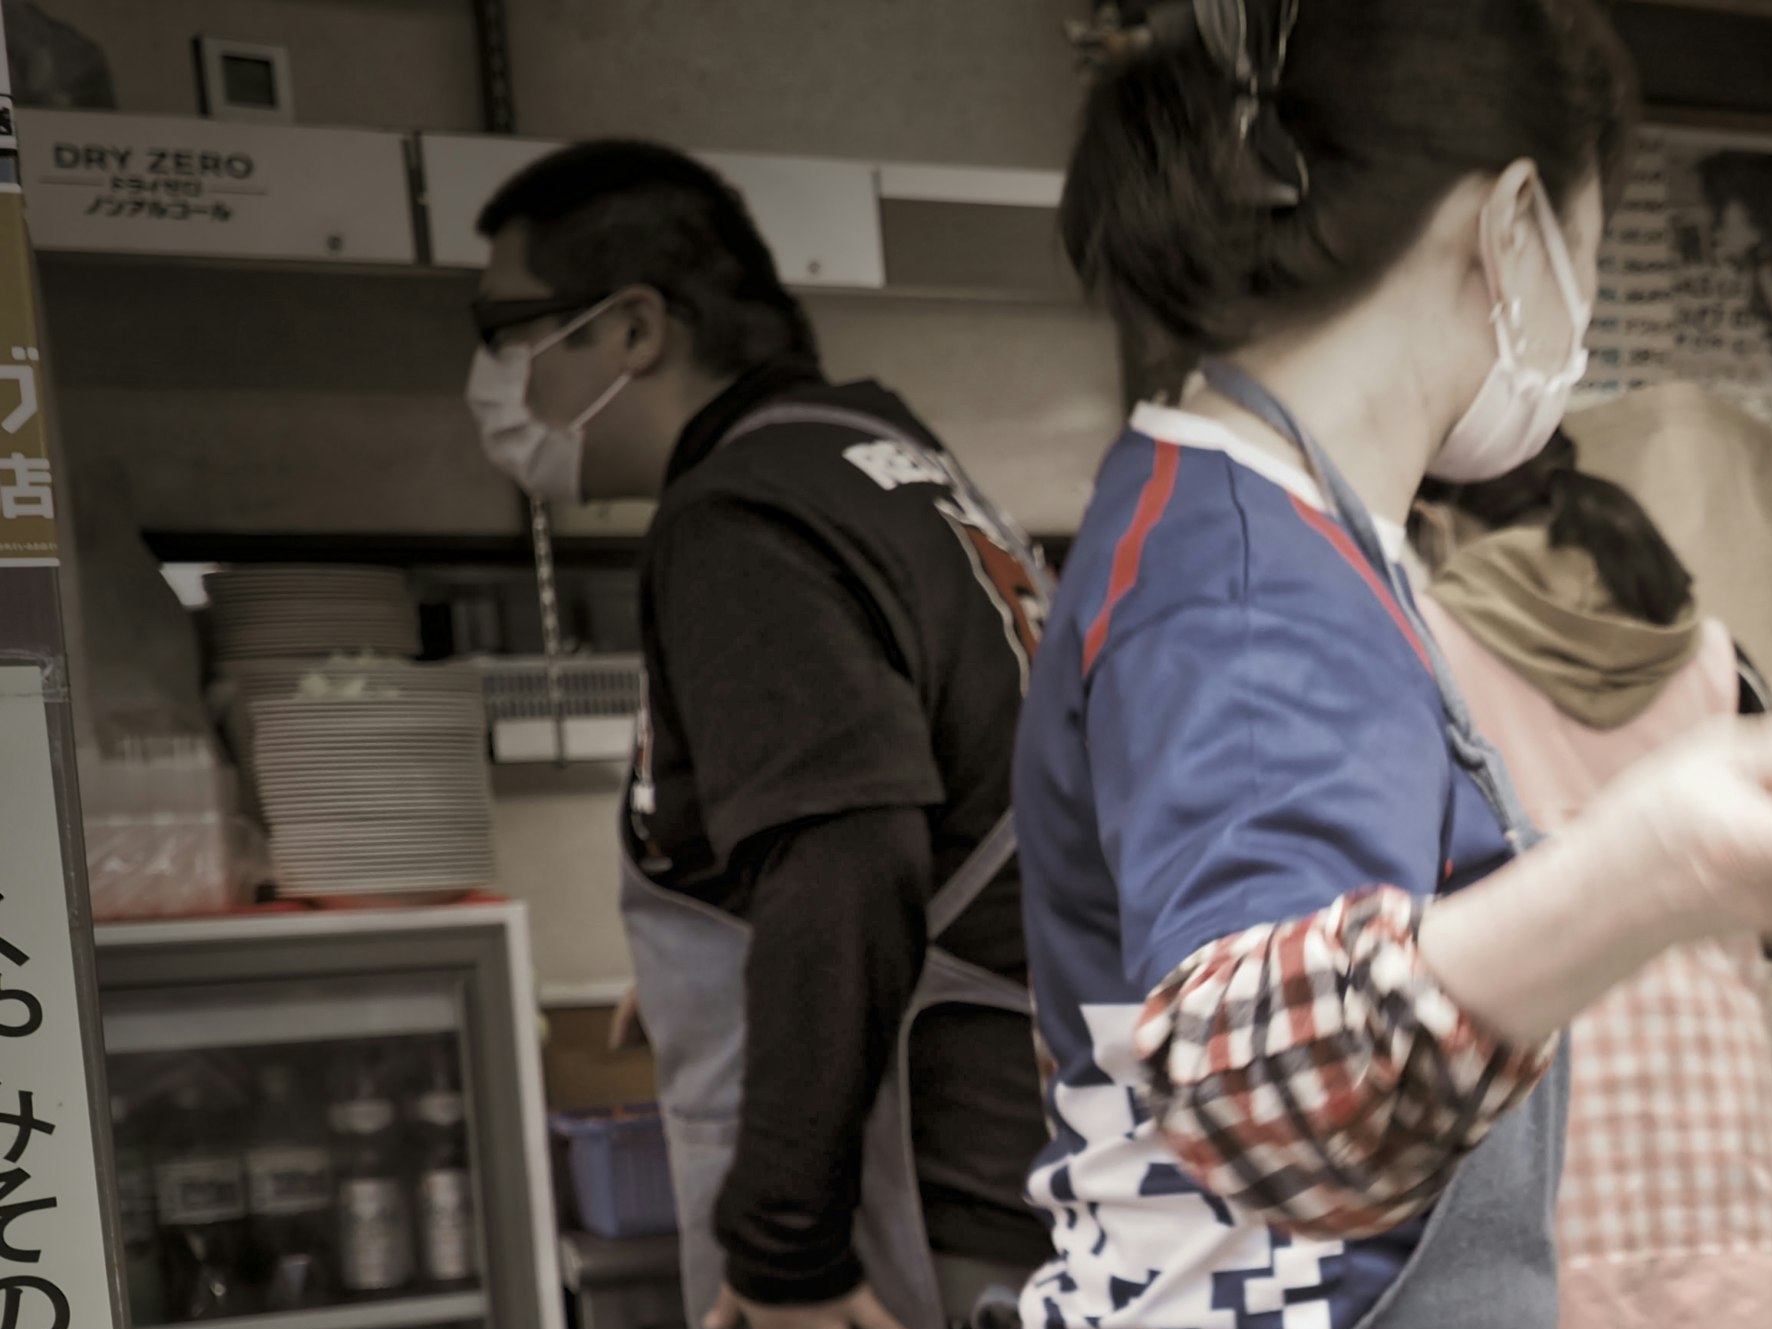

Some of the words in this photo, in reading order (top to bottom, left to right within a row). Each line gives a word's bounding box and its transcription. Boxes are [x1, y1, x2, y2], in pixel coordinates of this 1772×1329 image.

[53, 143, 131, 171] DRY
[146, 147, 255, 179] ZERO
[84, 194, 233, 221] ノンアルコール
